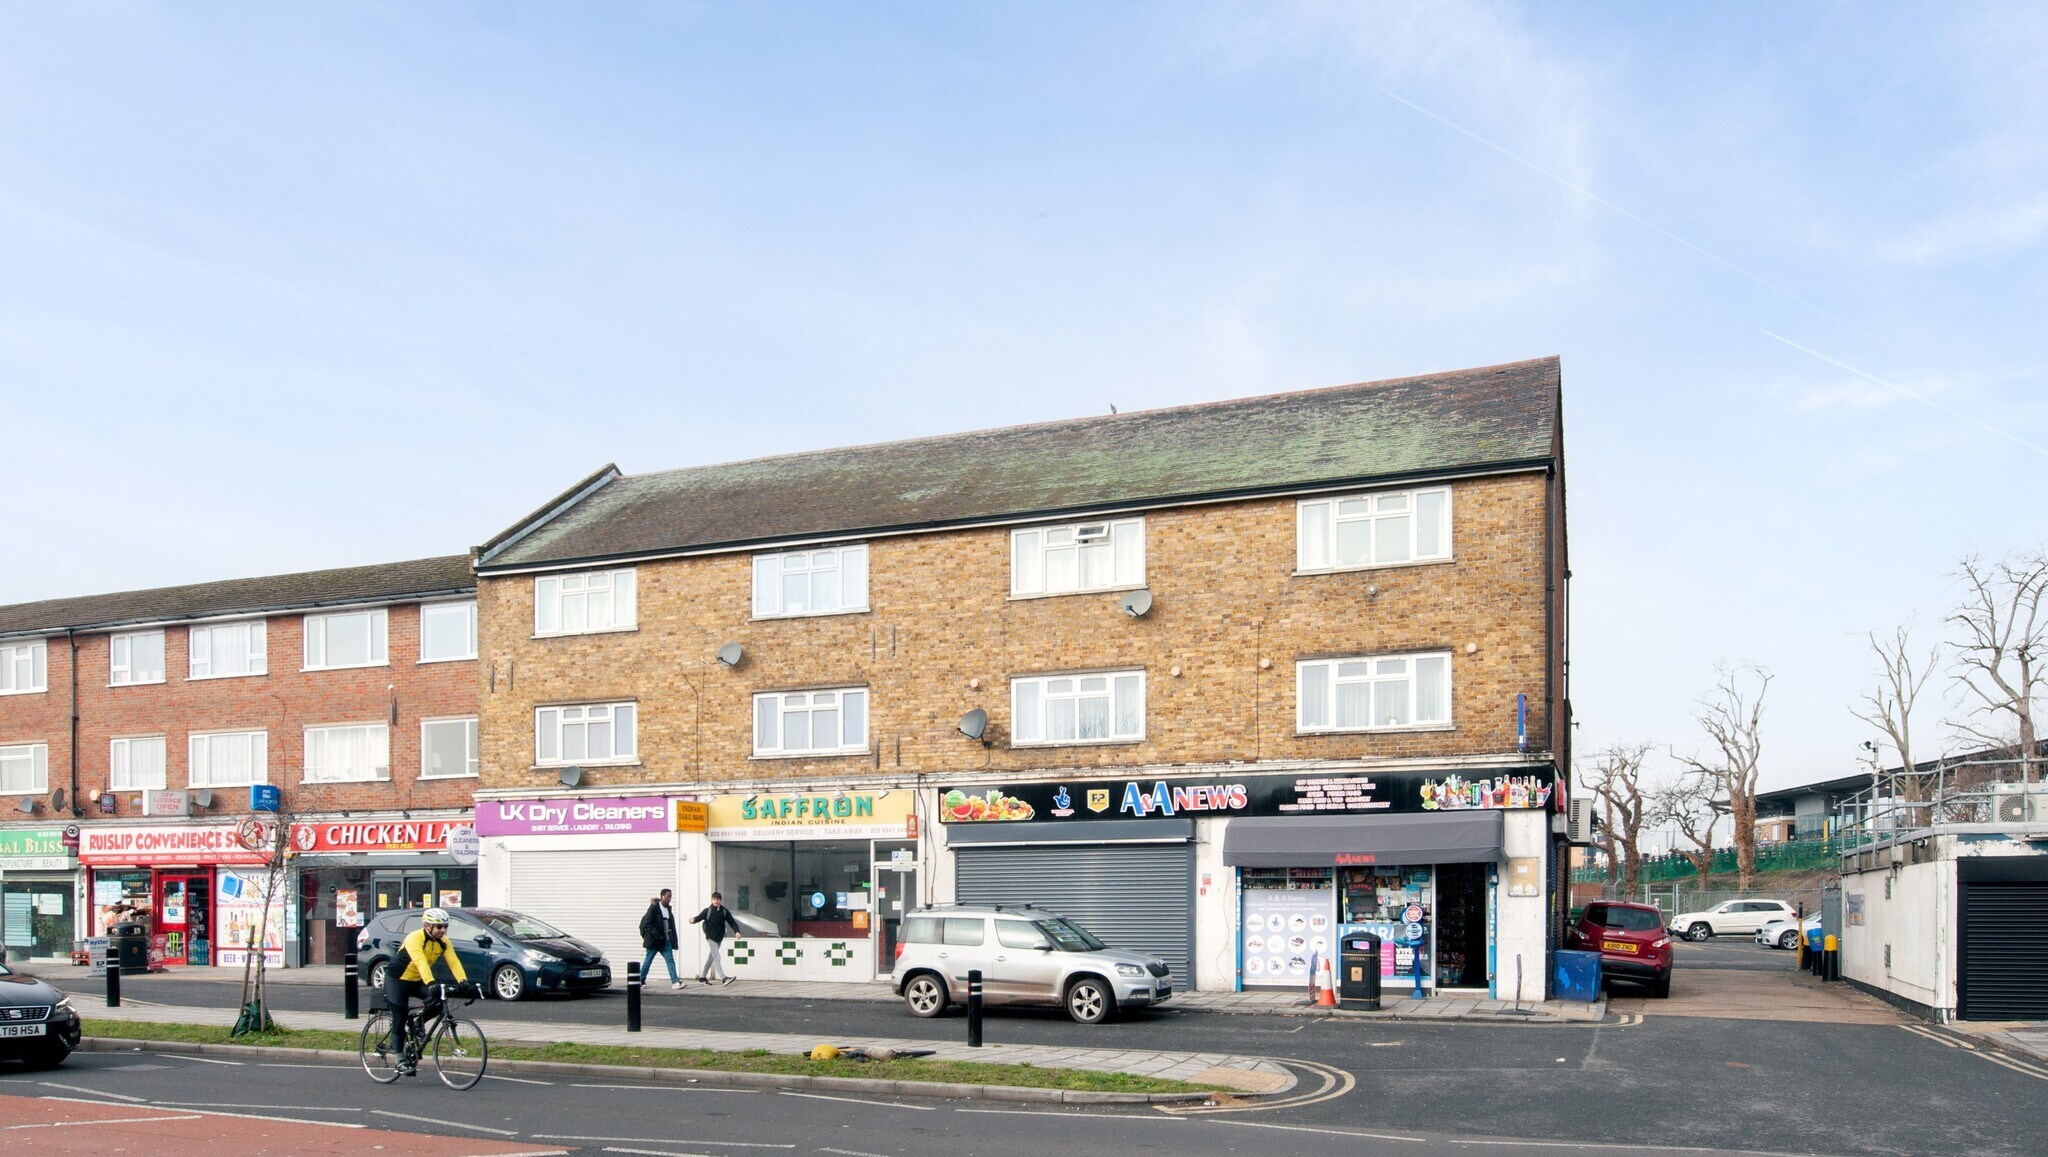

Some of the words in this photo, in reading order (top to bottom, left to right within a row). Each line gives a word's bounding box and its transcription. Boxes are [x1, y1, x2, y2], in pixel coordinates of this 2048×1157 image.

[1120, 781, 1174, 816] A&A
[1173, 784, 1248, 811] NEWS
[500, 804, 526, 821] UK
[529, 804, 567, 825] Dry
[573, 802, 665, 820] Cleaners
[742, 796, 873, 820] SAFFRON
[678, 813, 704, 822] TAKEAWAY
[326, 823, 422, 845] CHICKEN
[547, 824, 569, 832] SERVICE
[753, 828, 784, 836] DELIVERY
[786, 827, 813, 835] SERVICE
[824, 827, 862, 835] TAKE-AWAY
[25, 838, 64, 854] BLISS
[90, 834, 133, 850] RUISLIP
[136, 831, 222, 849] CONVENIENCE
[1352, 854, 1375, 863] NEWS
[90, 939, 109, 947] oyster
[223, 953, 236, 963] BEER
[241, 954, 255, 964] WE
[0, 1026, 18, 1037] T19
[21, 1025, 40, 1036] HSA
